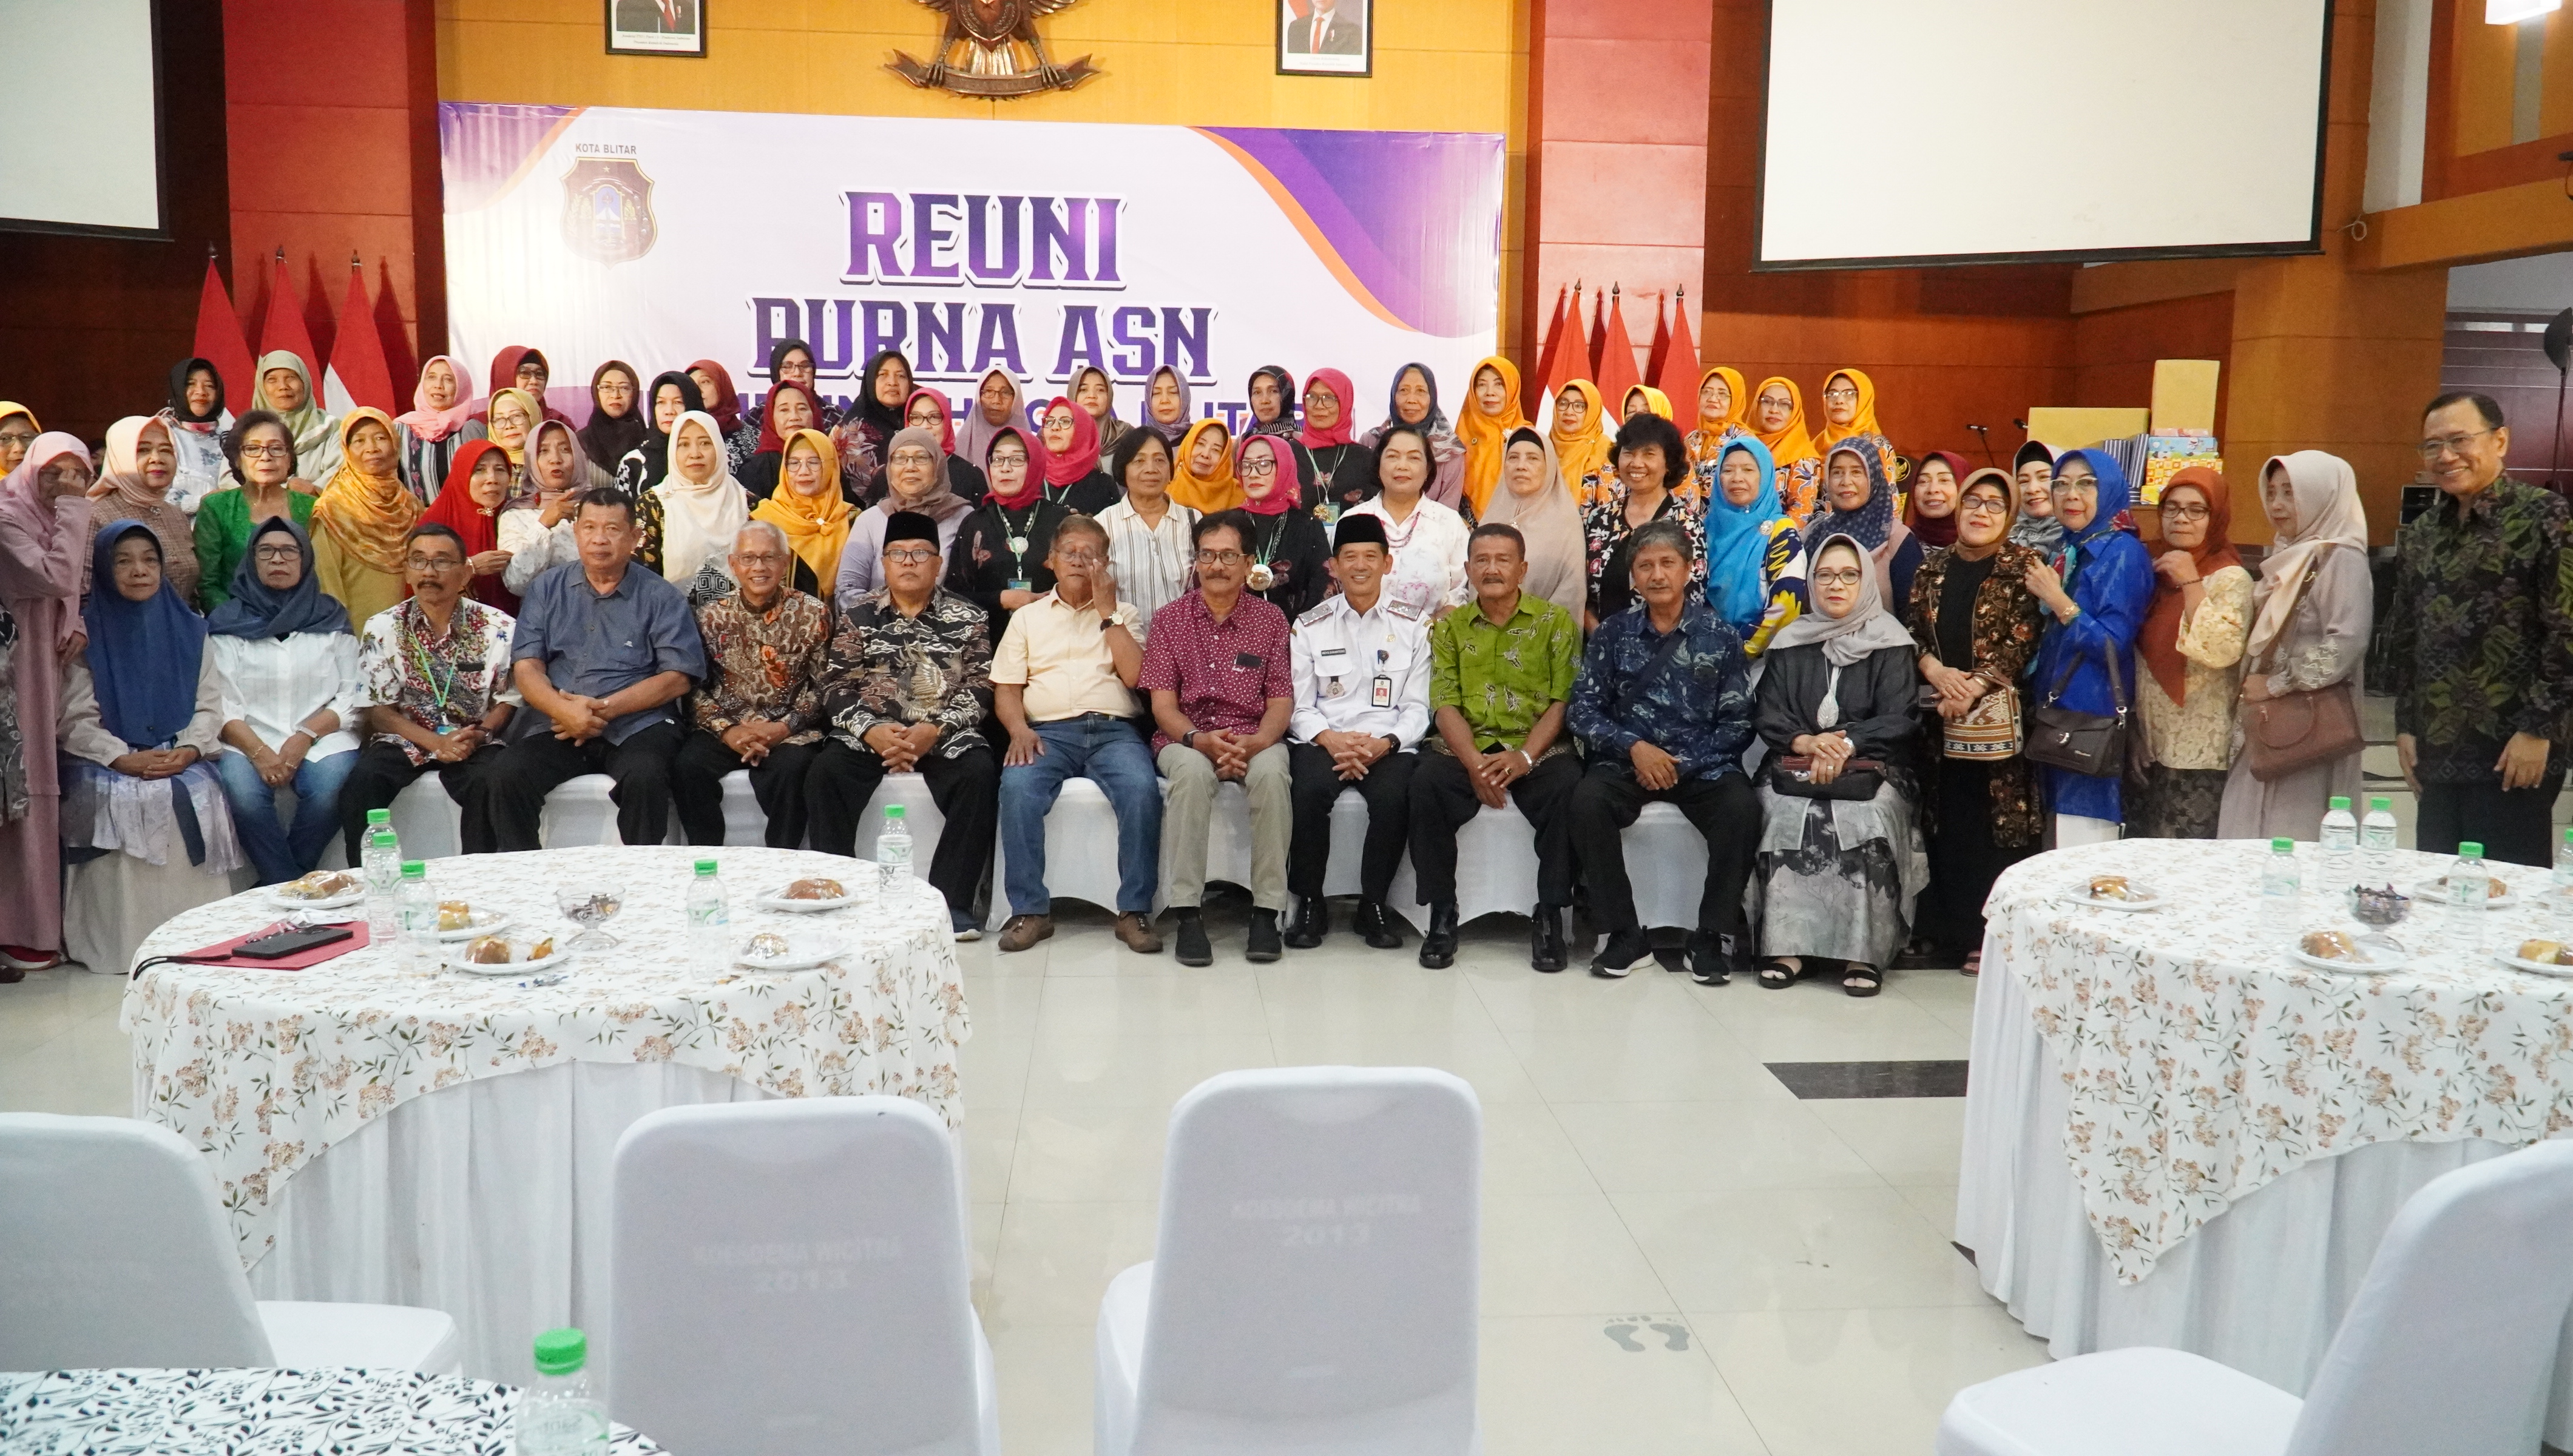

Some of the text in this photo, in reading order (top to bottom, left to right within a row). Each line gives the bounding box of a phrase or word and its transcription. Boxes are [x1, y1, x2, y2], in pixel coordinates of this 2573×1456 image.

[576, 143, 637, 155] KOTA BLITAR
[842, 190, 1124, 284] REUNI
[750, 297, 1215, 377] PURNA ASN
[1282, 1222, 1370, 1247] 2013
[754, 1269, 850, 1293] 2013
